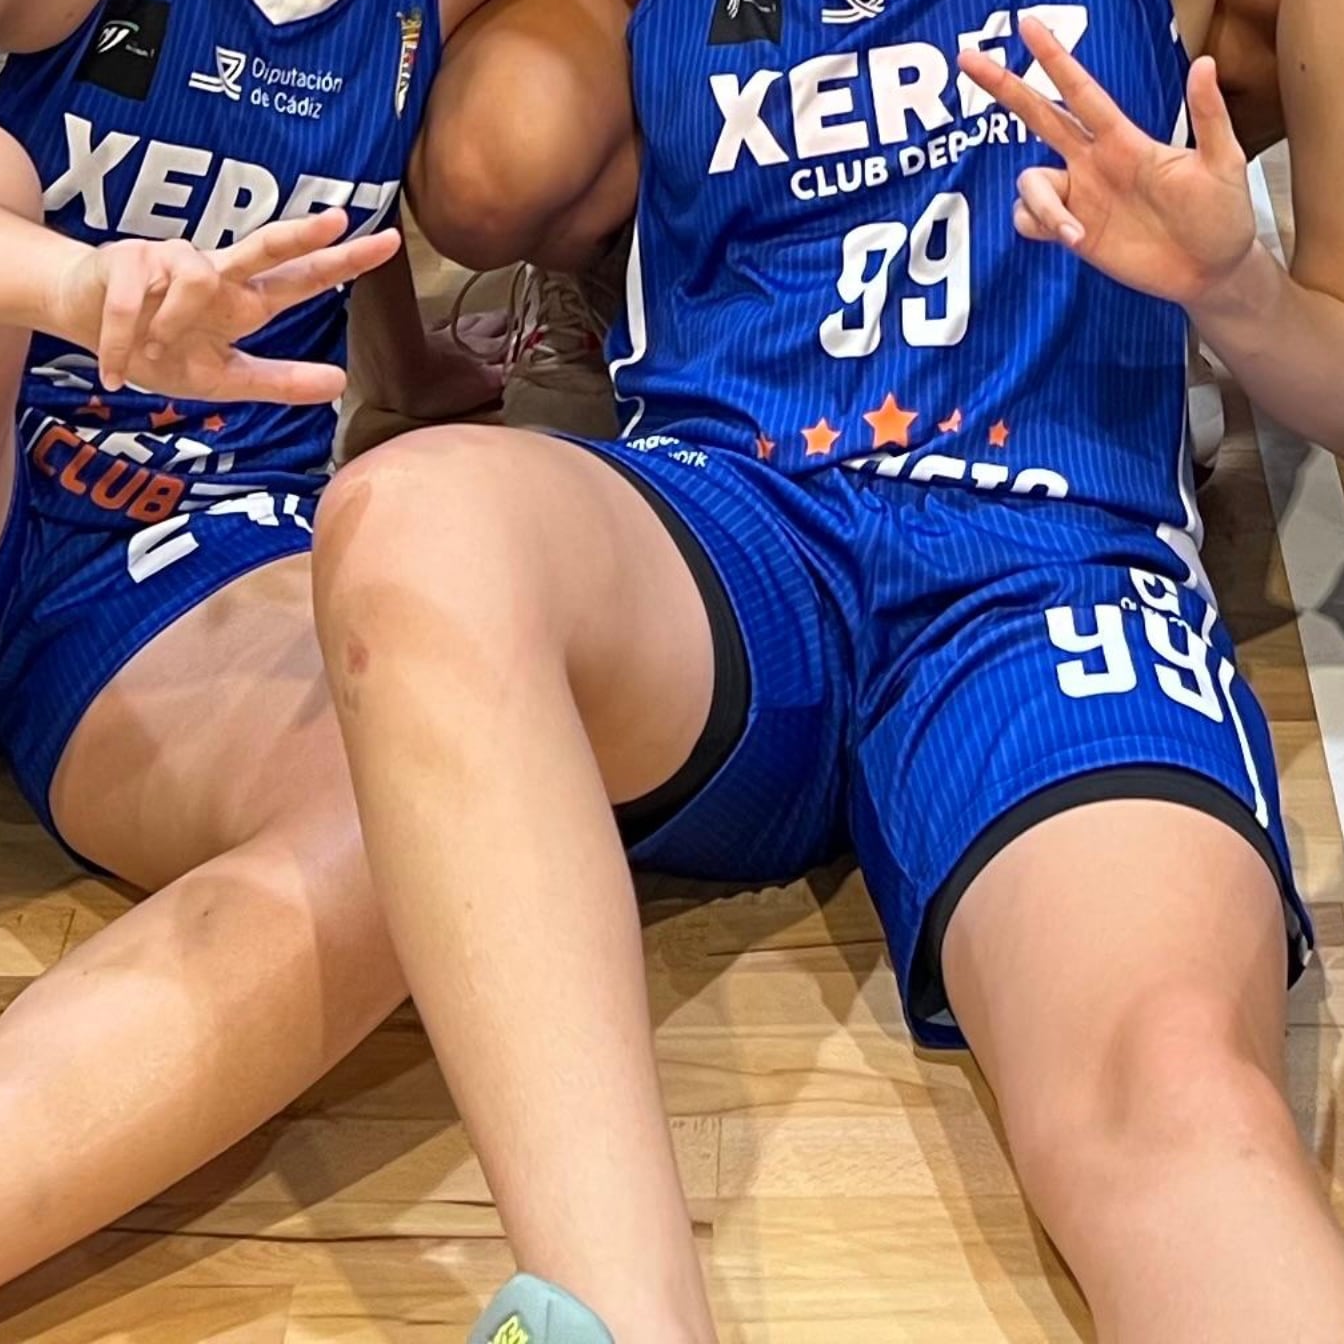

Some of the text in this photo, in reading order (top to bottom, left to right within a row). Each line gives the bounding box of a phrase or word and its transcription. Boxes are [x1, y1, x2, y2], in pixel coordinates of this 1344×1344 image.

[251, 56, 343, 93] Diputación
[251, 87, 323, 119] de Cádiz
[790, 156, 888, 201] CLUB
[819, 191, 970, 359] 99
[32, 424, 186, 523] CLUB
